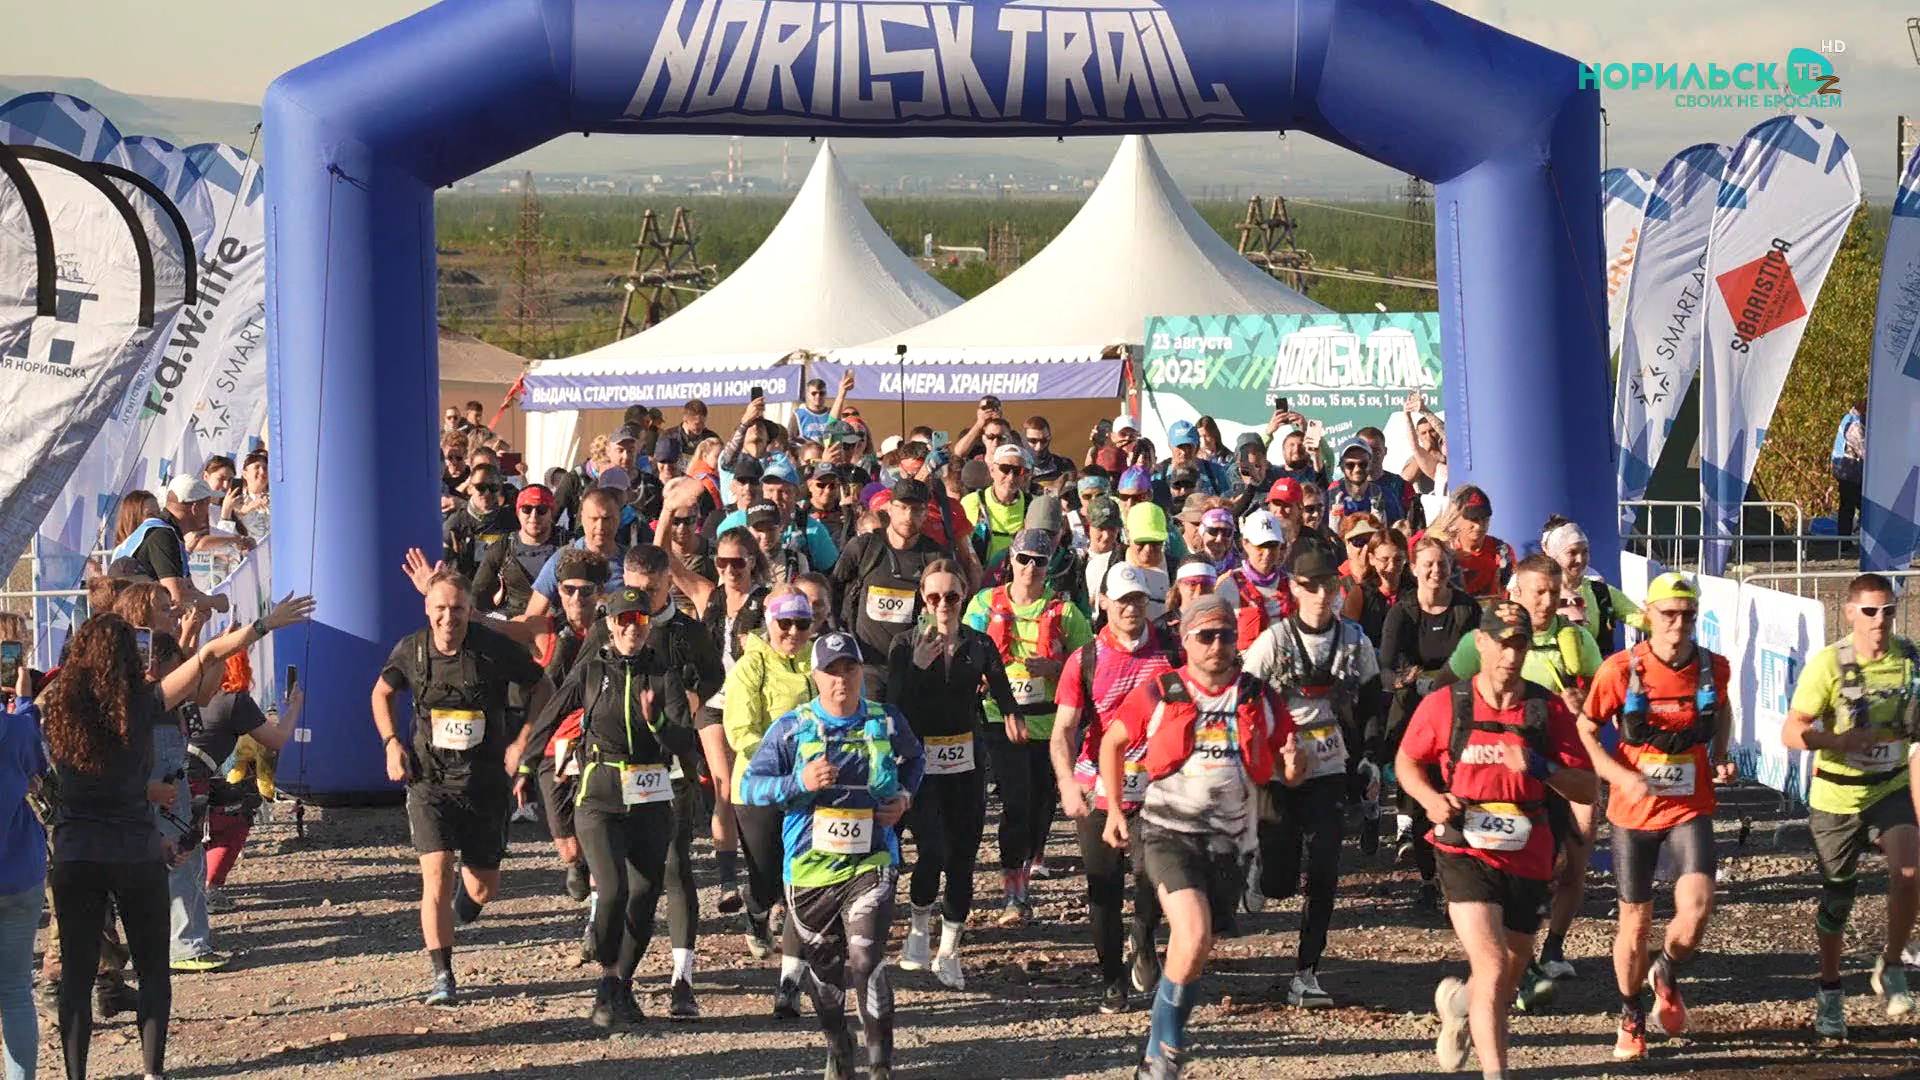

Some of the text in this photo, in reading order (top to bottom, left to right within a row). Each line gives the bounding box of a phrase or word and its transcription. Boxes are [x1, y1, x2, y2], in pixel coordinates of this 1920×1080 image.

[997, 7, 1244, 120] TRAIL
[1730, 238, 1792, 353] SIBARISTICA
[144, 237, 248, 416] r.a.w.life
[1657, 286, 1699, 360] SMART
[1152, 333, 1233, 354] 23 августа
[216, 317, 265, 393] SMART
[15, 360, 87, 380] НОРИЛЬСКА
[1150, 358, 1206, 384] 2025
[532, 386, 582, 405] ВЫДАЧА
[583, 384, 654, 403] СТАРТОВЫХ
[656, 382, 709, 401] ПАКЕТОВ
[712, 381, 722, 398] И
[878, 372, 1040, 394] КАМЕРА ХРАНЕНИЯ
[1297, 393, 1311, 407] 30
[1329, 393, 1340, 407] 15
[878, 598, 904, 610] 509
[445, 722, 473, 736] 455
[937, 746, 965, 761] 452
[636, 772, 661, 787] 497
[1652, 767, 1683, 782] 442
[828, 822, 861, 838] 436
[1481, 816, 1516, 834] 493
